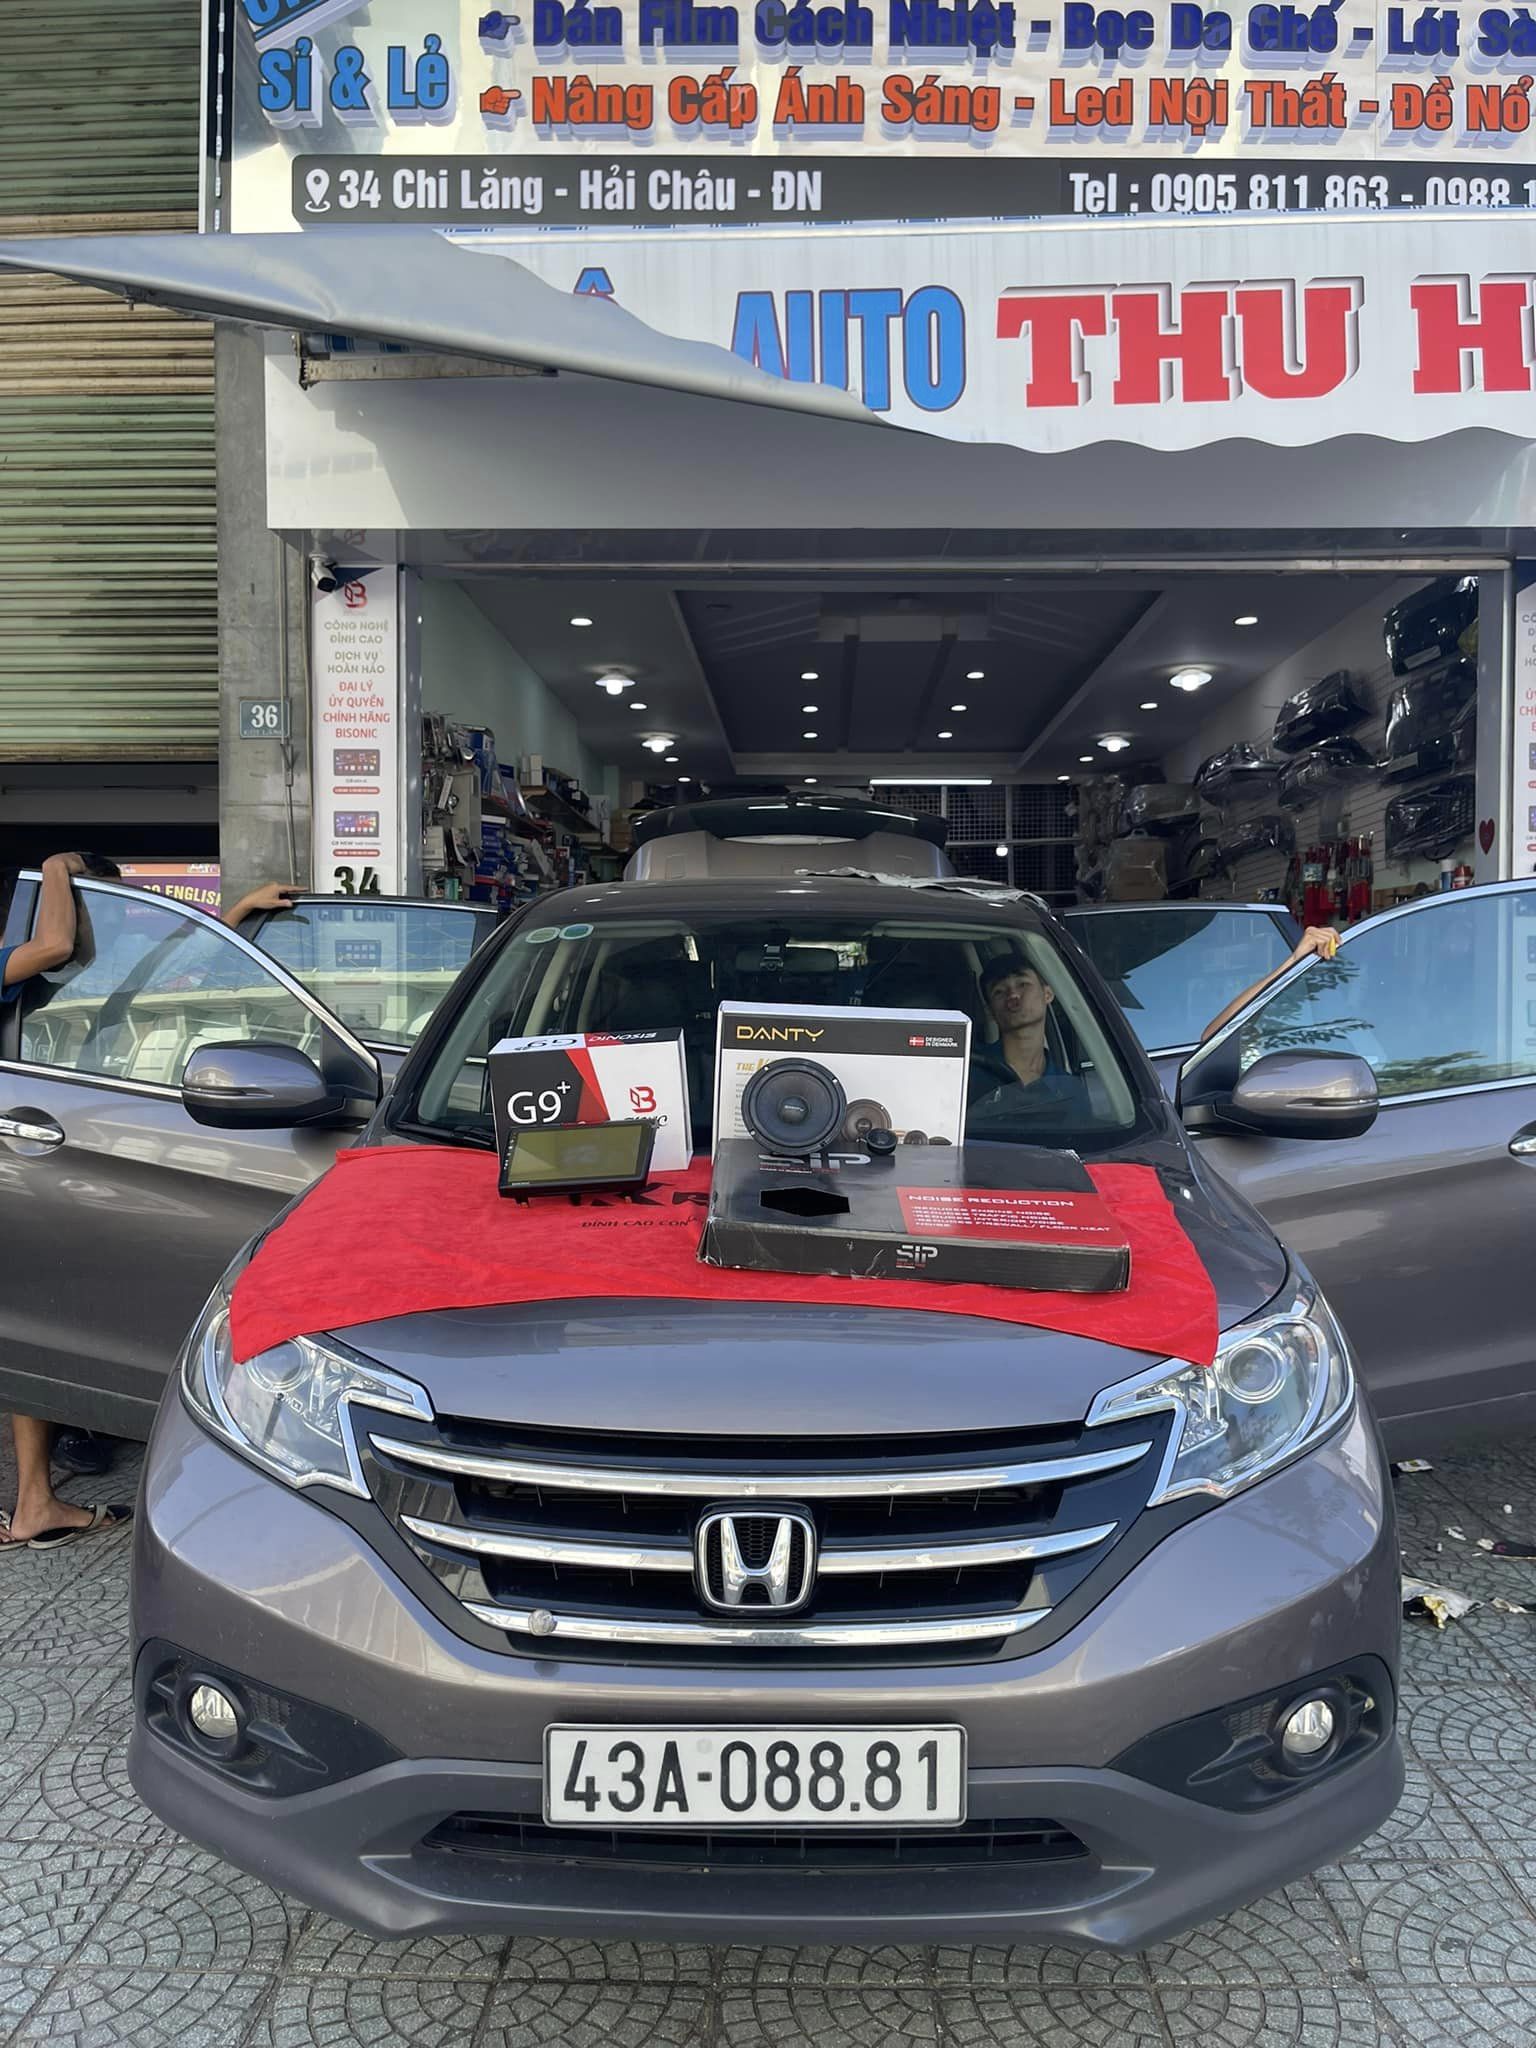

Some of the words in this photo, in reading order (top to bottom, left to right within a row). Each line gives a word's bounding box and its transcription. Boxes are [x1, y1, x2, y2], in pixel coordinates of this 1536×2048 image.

[533, 0, 622, 46] Dán
[639, 0, 738, 46] Film
[755, 0, 873, 46] Cách
[889, 0, 1016, 57] Nhiệt
[1064, 2, 1154, 59] Bọc
[1171, 3, 1232, 50] Da
[1388, 7, 1460, 57] Lót
[258, 36, 313, 112] Sỉ
[330, 46, 371, 110] &
[388, 34, 449, 109] Lẻ
[532, 75, 653, 129] Nâng
[668, 67, 757, 129] Cấp
[773, 66, 864, 123] Ánh
[881, 74, 1000, 131] Sáng
[1050, 78, 1133, 125] Led
[1150, 77, 1229, 136] Nội
[1244, 72, 1347, 128] Thất
[1390, 76, 1454, 130] Đề
[1466, 75, 1534, 132] Nổ
[338, 170, 381, 209] 34
[393, 169, 449, 209] Chi
[461, 168, 543, 214] Lăng
[580, 165, 635, 209] Hải
[648, 168, 736, 211] Châu
[772, 170, 822, 211] ĐN
[1069, 173, 1117, 213] Tel
[1151, 173, 1237, 213] 0905
[1249, 174, 1308, 210] 811
[1325, 175, 1389, 208] 863
[1426, 177, 1510, 207] 0988
[731, 285, 966, 412] AUTO
[997, 278, 1362, 408] THU
[324, 619, 357, 630] CÔNG
[359, 635, 383, 644] CAO
[335, 651, 361, 662] DỊCH
[251, 704, 277, 728] 36
[323, 710, 356, 722] CHÍNH
[335, 728, 378, 738] BISONIC
[334, 866, 380, 896] 34
[737, 1025, 824, 1043] DANTY
[909, 1195, 963, 1204] NOISE
[968, 1197, 1074, 1207] REDUCTION
[563, 1739, 938, 1813] 43A-088.81
